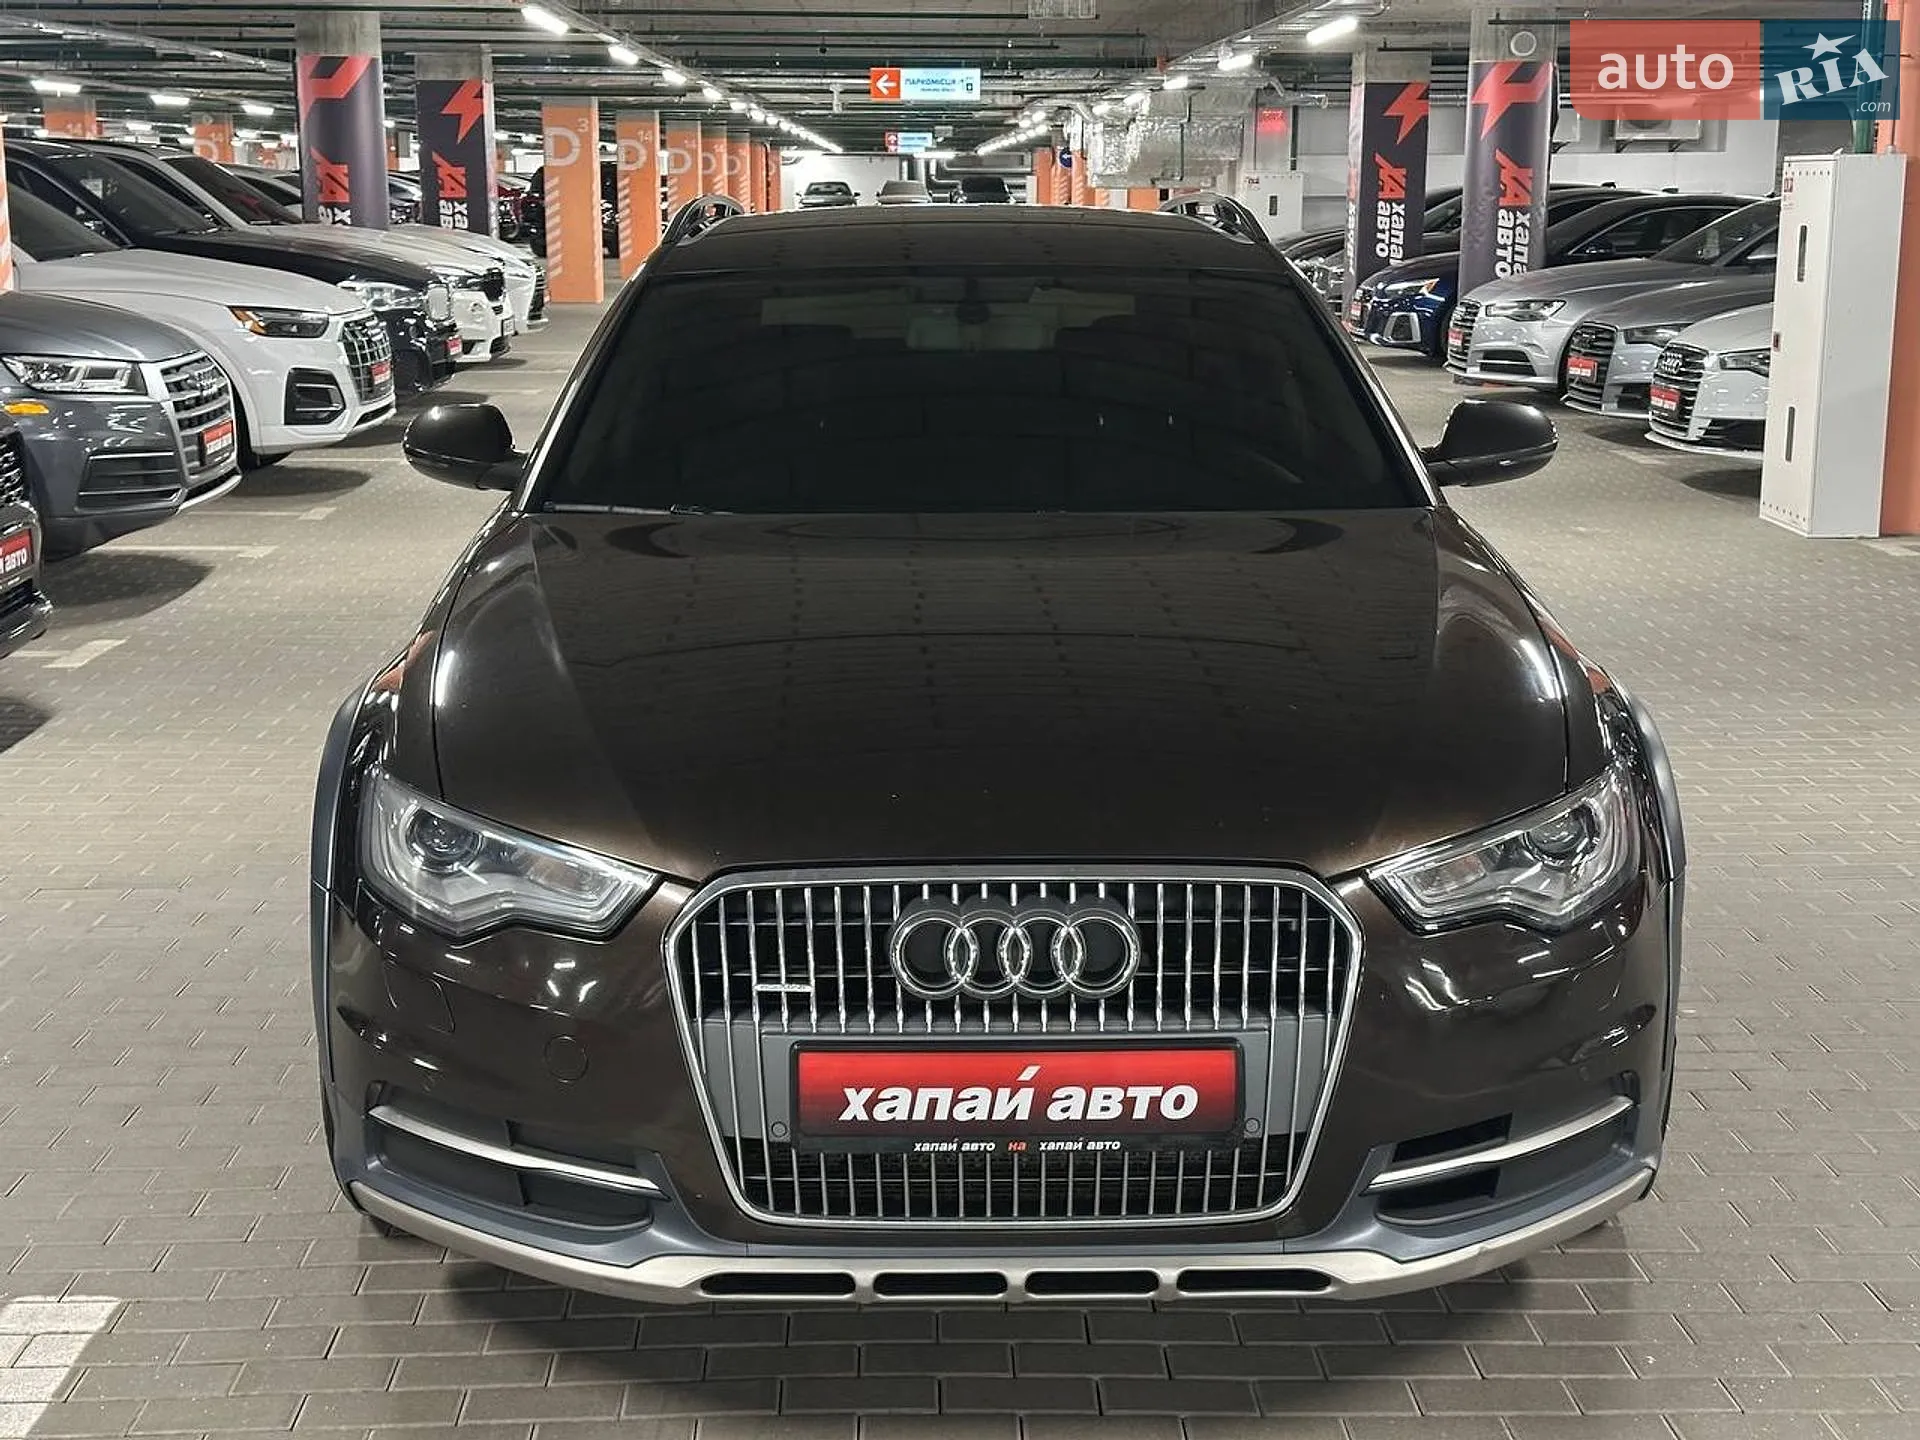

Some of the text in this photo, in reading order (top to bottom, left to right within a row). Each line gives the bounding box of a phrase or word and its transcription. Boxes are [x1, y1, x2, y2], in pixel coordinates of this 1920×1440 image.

[544, 117, 589, 167] D 3
[617, 139, 647, 170] D
[1375, 200, 1391, 258] авто
[1494, 208, 1514, 279] авто
[1046, 1085, 1199, 1120] авто
[961, 1141, 995, 1151] авто
[1007, 1141, 1028, 1151] на
[1086, 1140, 1121, 1151] авто
